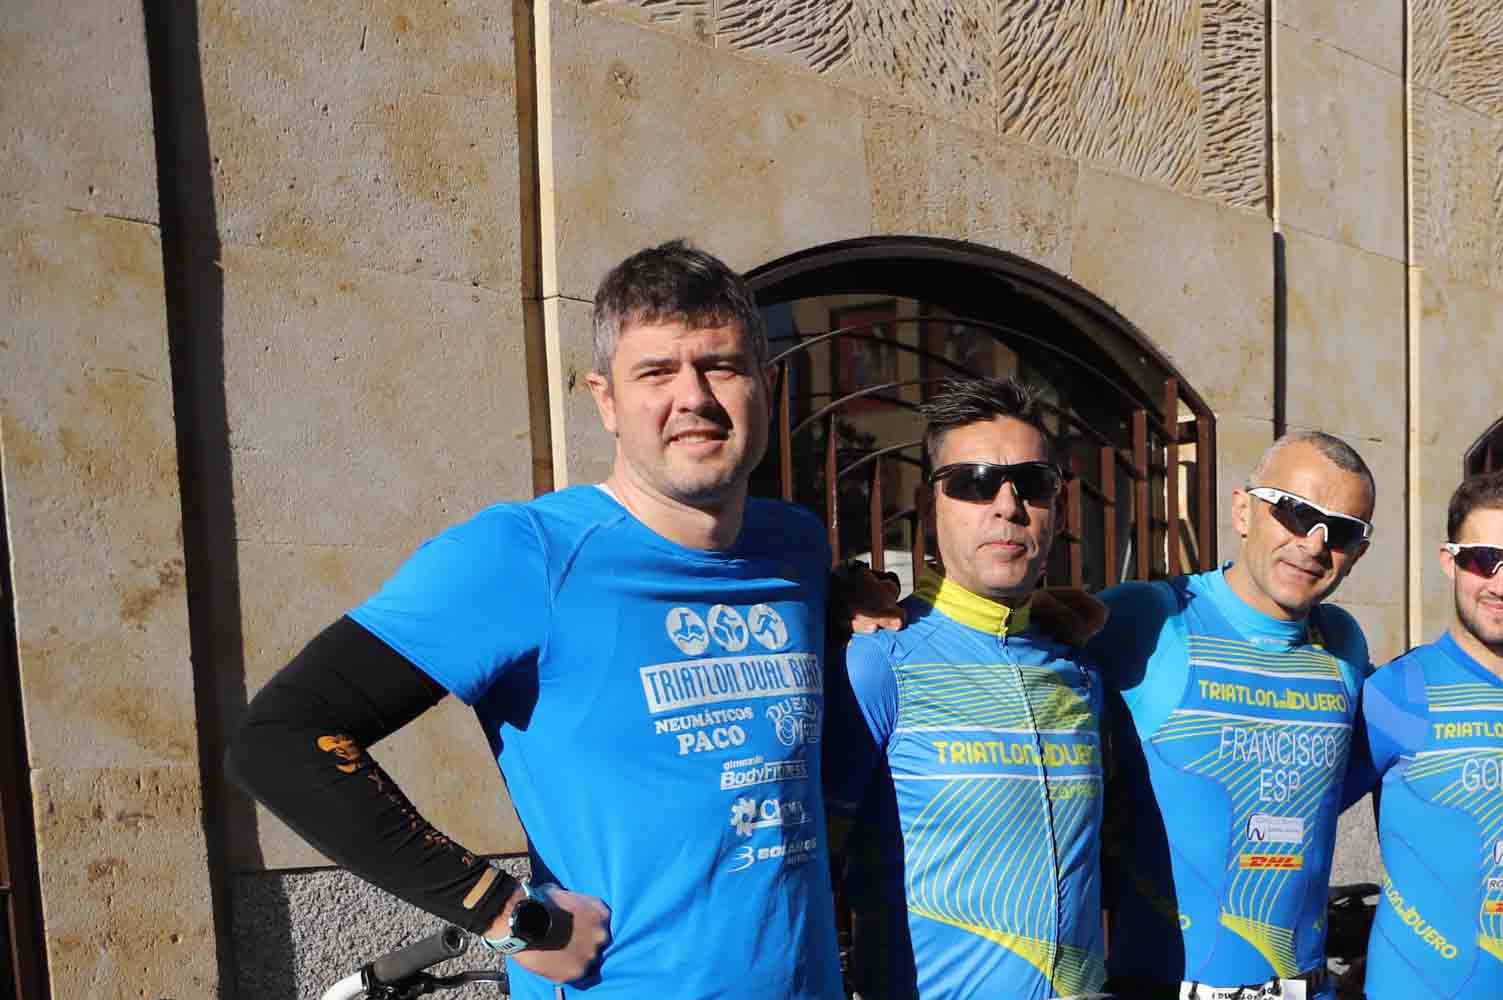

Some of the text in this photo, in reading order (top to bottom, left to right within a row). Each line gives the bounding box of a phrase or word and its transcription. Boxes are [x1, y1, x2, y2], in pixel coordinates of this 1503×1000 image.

[744, 658, 787, 697] DUAL
[677, 724, 745, 755] PACO
[1218, 726, 1337, 768] FRANCISCO
[1259, 768, 1300, 802] ESP
